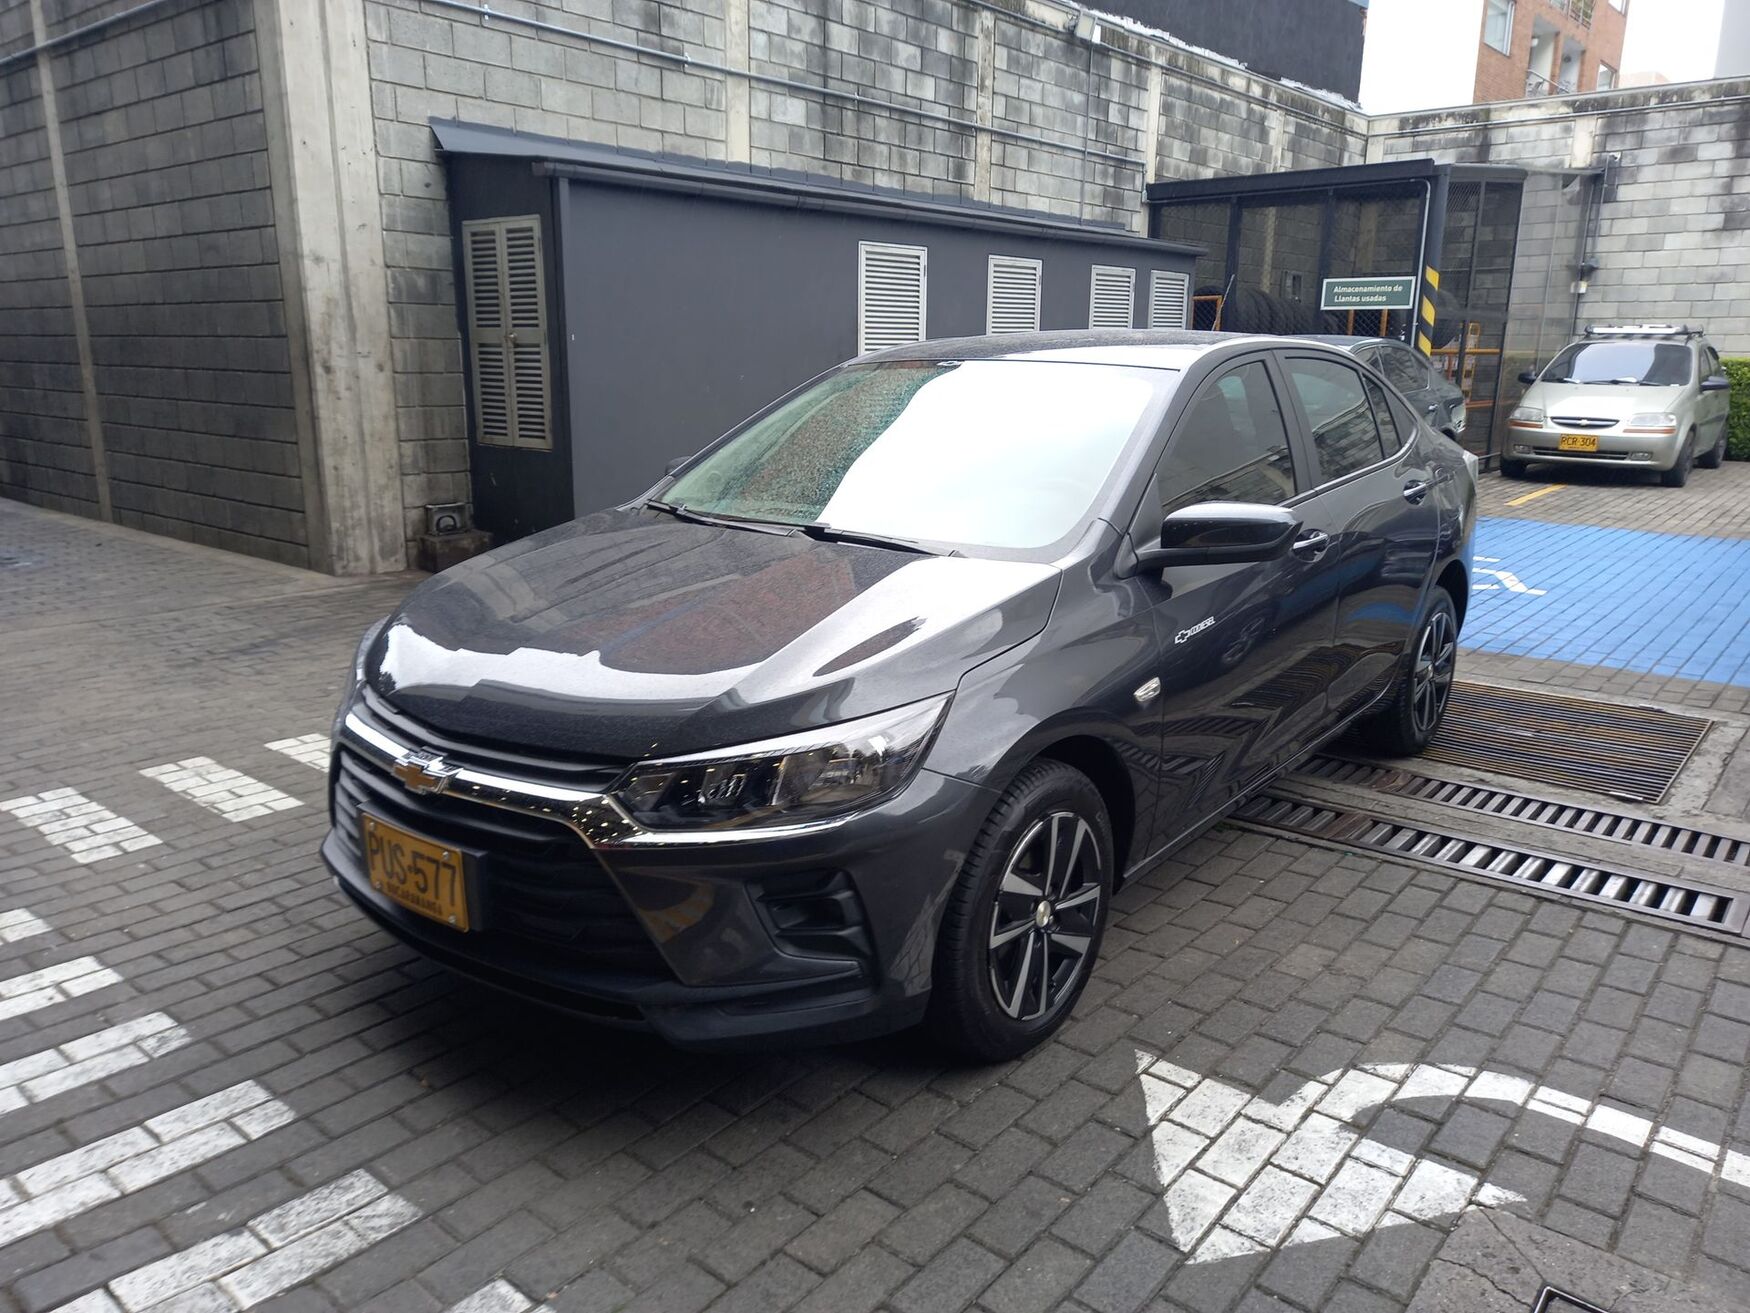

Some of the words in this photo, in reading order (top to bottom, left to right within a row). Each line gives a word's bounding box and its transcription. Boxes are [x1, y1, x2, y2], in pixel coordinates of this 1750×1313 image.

[1333, 285, 1392, 293] Almacenamiento
[1393, 284, 1403, 292] de
[1334, 295, 1360, 303] Llantas
